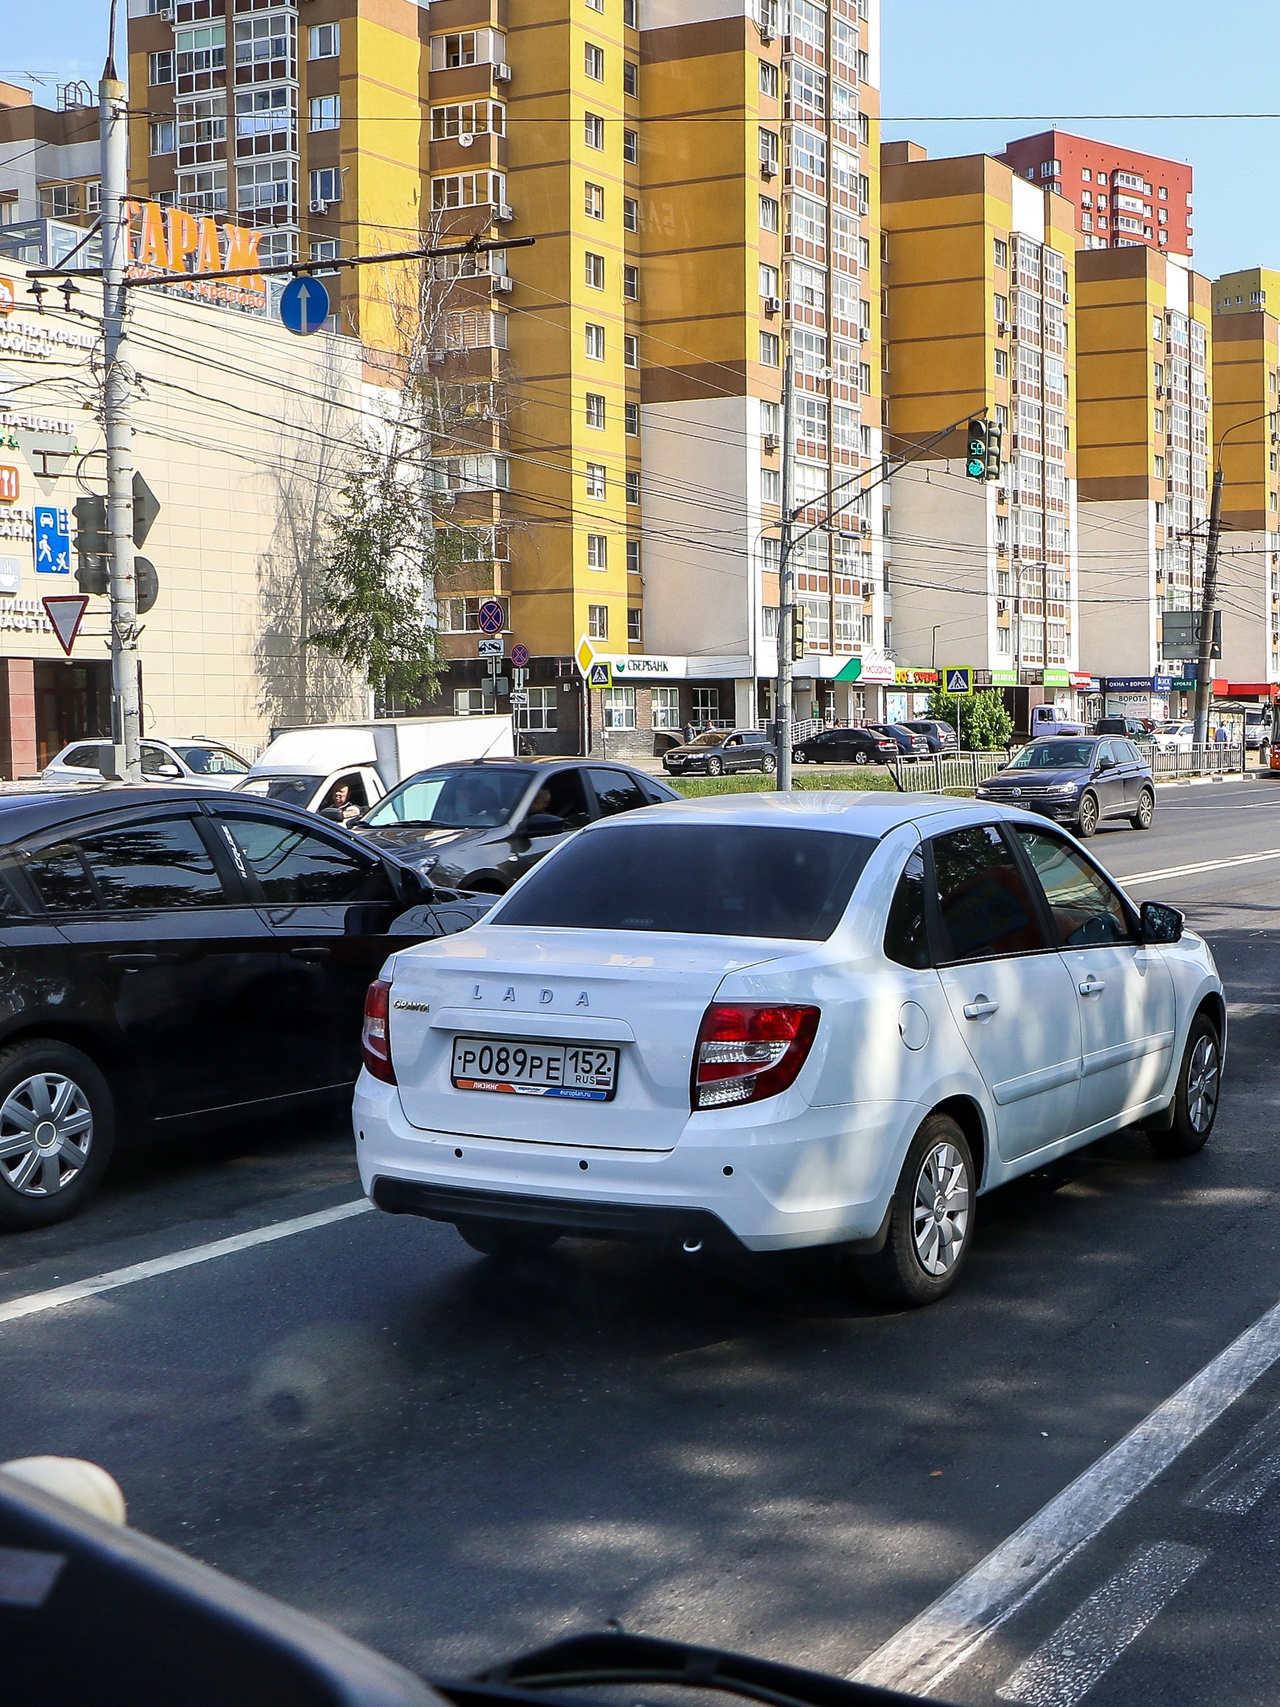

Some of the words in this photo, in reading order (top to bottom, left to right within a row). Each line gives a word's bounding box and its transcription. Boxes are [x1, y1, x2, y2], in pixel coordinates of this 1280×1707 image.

[198, 283, 266, 309] красиво
[22, 323, 46, 339] НА
[627, 659, 669, 672] СБЕРБАНК
[472, 984, 590, 1006] LADA
[461, 1044, 561, 1081] Р089РЕ
[568, 1050, 608, 1076] 152
[473, 1082, 499, 1090] ЛИЗИНГ
[575, 1074, 595, 1085] RUS
[559, 1089, 592, 1099] europlan.ru
